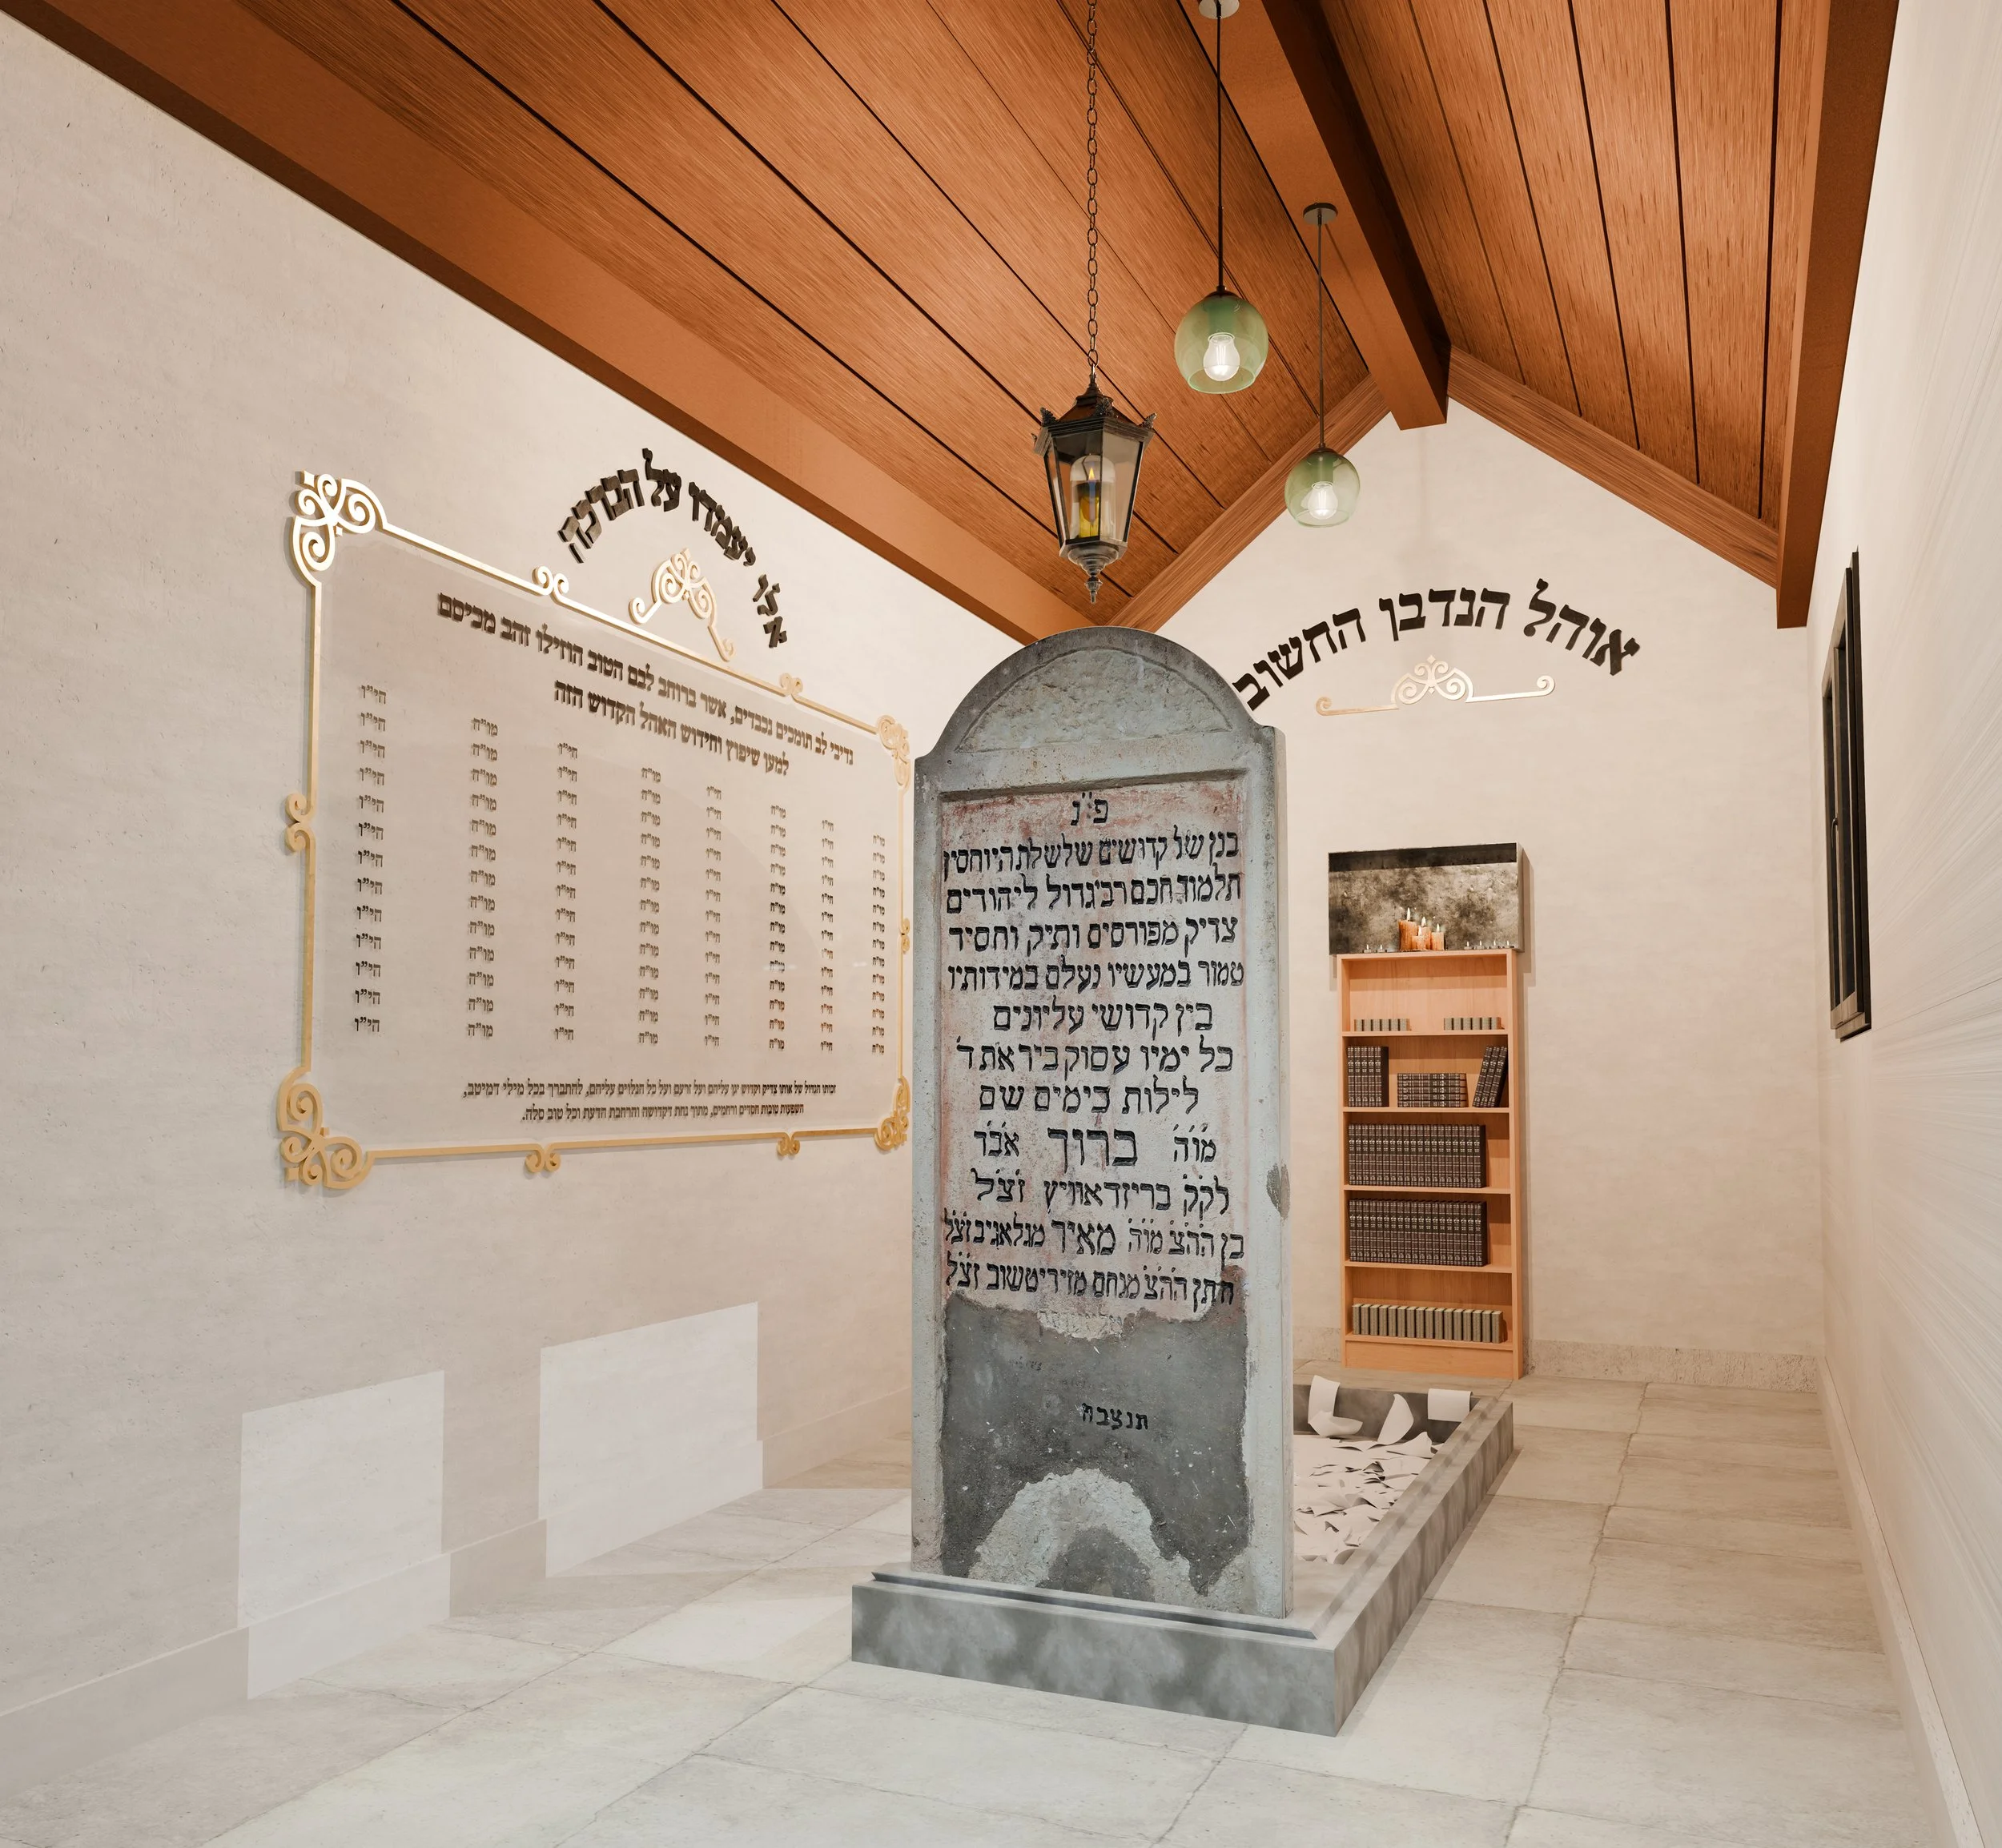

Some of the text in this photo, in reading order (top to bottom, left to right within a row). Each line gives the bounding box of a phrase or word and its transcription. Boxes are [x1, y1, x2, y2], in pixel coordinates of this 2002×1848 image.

[557, 448, 788, 649] אלו יעמדו על הברכה
[1232, 577, 1641, 712] אוהל הנדבן החשוב
[438, 593, 854, 765] נדיבי לב תומכים נכבדים, אשר ברוחב לבם הטוב הוזילו זהב מכיסם
[554, 680, 790, 776] למען שיפוץ וחידוש האהל הקדוש הזה
[1015, 833, 1093, 870] שלשלת
[1099, 837, 1168, 870] קדושים
[1173, 825, 1204, 860] של
[943, 846, 1013, 882] היוחסין
[947, 873, 1038, 914] ליהודים
[1131, 877, 1172, 905] חכם
[1177, 862, 1240, 902] תלמוד
[949, 917, 1238, 958] צדיק מפורסים ותיק וחסיד
[948, 954, 1244, 994] טמור במעשיו נעלם במידותיו
[993, 994, 1212, 1041] בין קדושי עליונים
[1064, 1044, 1130, 1081] עסוק
[1140, 1044, 1189, 1072] ימיו
[1200, 1034, 1233, 1072] כל
[463, 1083, 500, 1098] דמיטב,
[503, 1078, 525, 1095] מילי
[527, 1078, 545, 1095] בכל
[548, 1079, 583, 1097] להתברך
[647, 1079, 656, 1095] כל
[659, 1079, 671, 1095] ועל
[693, 1079, 706, 1095] ועל
[979, 1075, 1199, 1115] לילות כימים שם
[548, 1107, 563, 1120] טוב
[566, 1103, 581, 1119] וכל
[583, 1107, 606, 1120] הדעת
[1047, 1127, 1137, 1174] ברוך
[1051, 1219, 1116, 1255] מאיר
[1221, 1232, 1244, 1271] בן
[1093, 1270, 1140, 1299] מנחם
[1192, 1278, 1234, 1312] חתן
[1082, 1403, 1148, 1431] תנצבה
